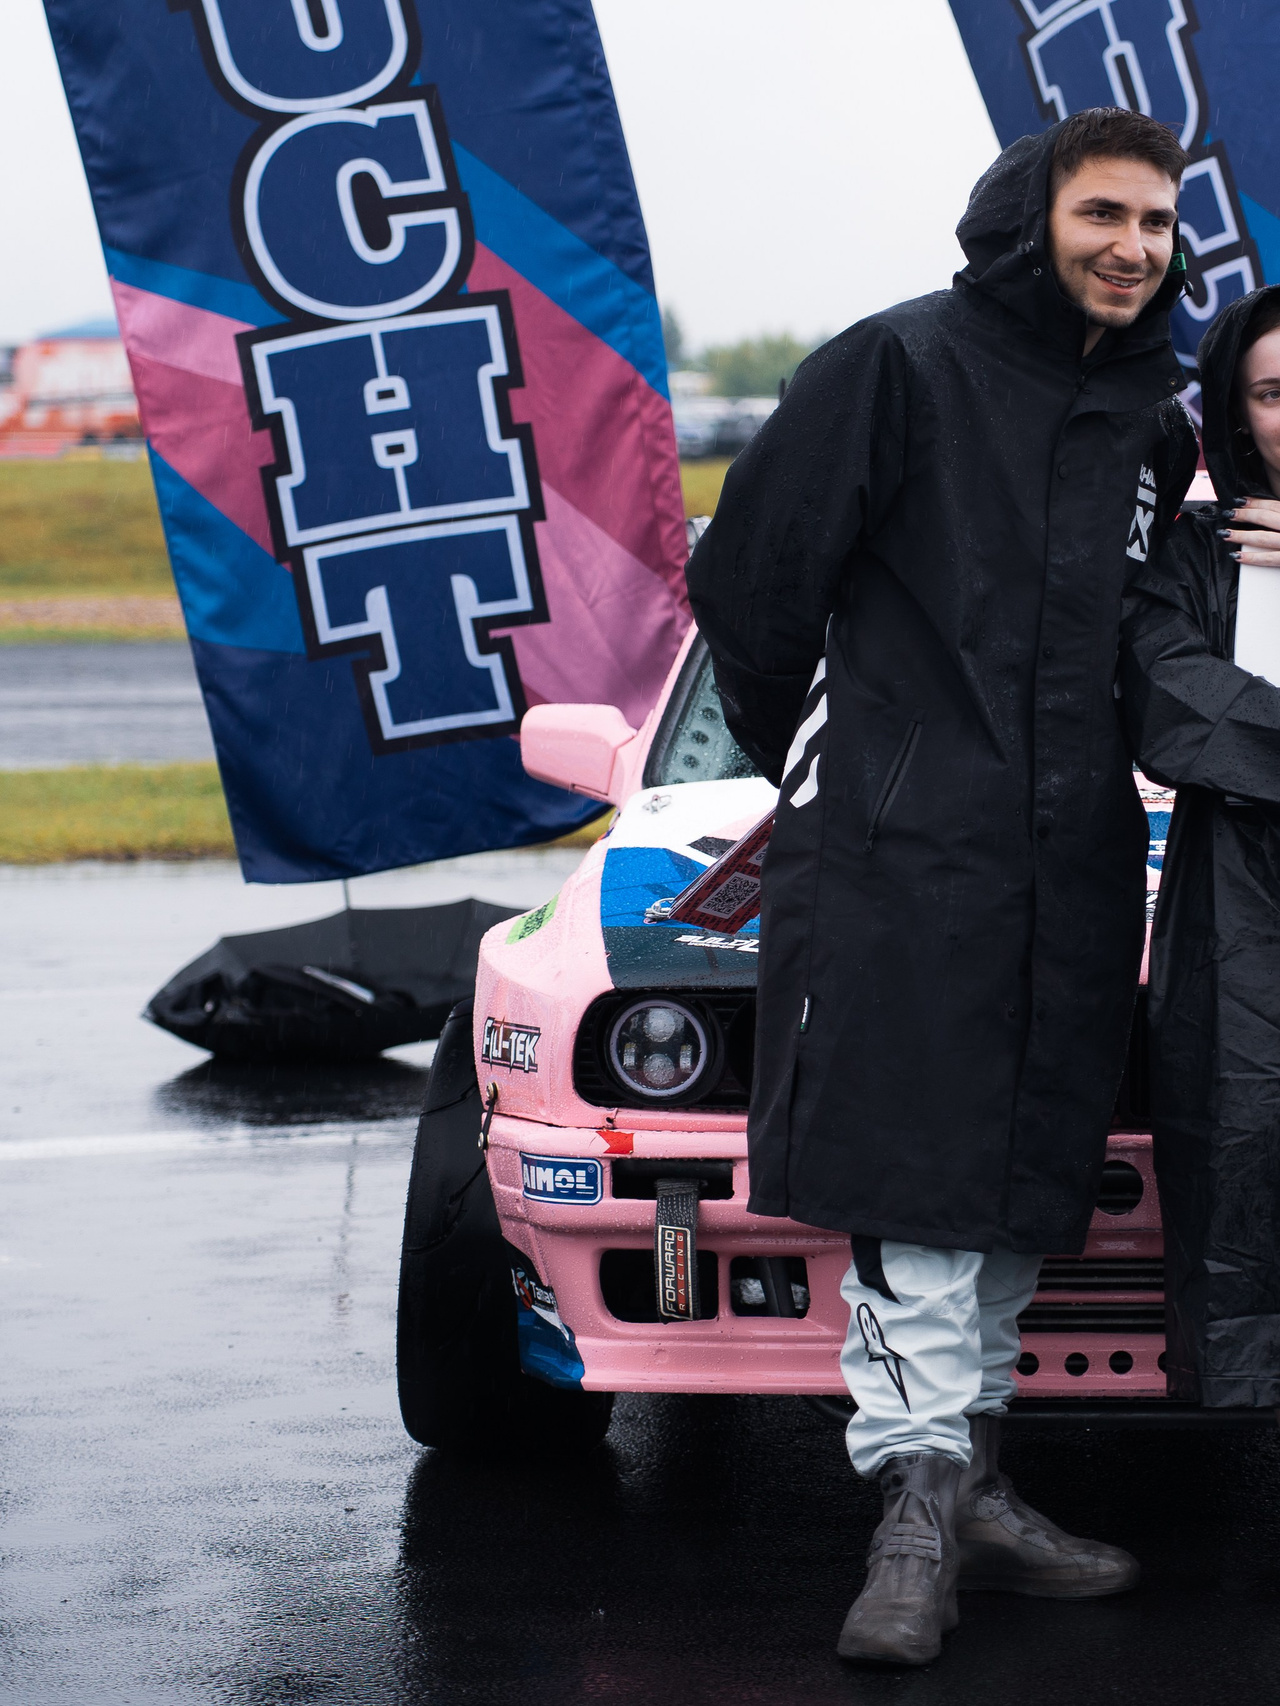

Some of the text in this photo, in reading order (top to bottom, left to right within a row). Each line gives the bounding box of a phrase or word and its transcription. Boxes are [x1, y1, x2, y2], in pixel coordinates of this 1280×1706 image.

[523, 1163, 595, 1194] AIMOL
[664, 1229, 677, 1312] FORWARD
[677, 1235, 686, 1311] RACING
